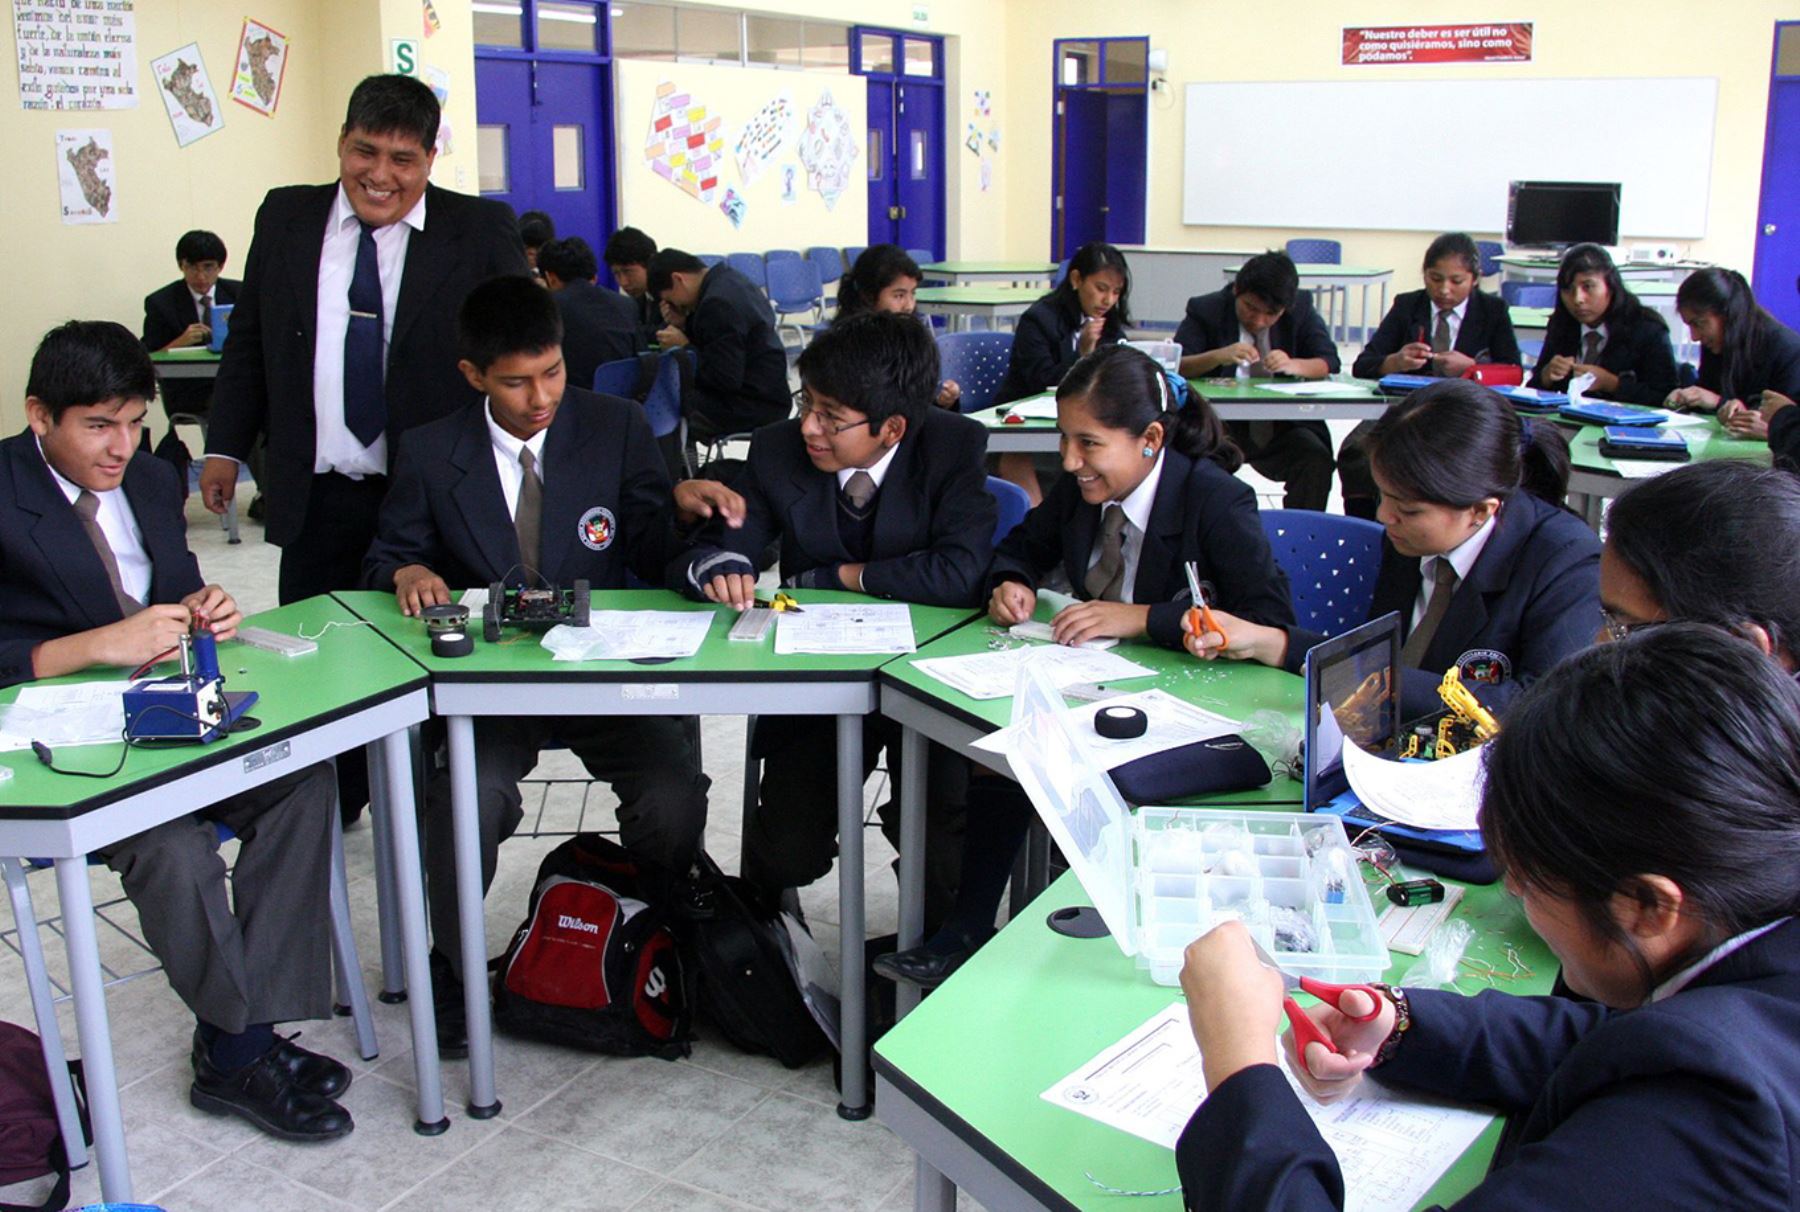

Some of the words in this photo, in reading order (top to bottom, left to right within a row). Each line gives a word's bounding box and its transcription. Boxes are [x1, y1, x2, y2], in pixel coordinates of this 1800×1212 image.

[65, 24, 75, 41] la
[1407, 28, 1439, 38] deber
[1440, 30, 1453, 38] es
[1454, 29, 1471, 38] ser
[1472, 26, 1491, 37] útil
[1493, 28, 1508, 37] no
[1359, 42, 1388, 50] como
[1458, 38, 1481, 48] sino
[1482, 40, 1513, 48] como
[397, 43, 414, 74] S
[558, 914, 598, 935] Wilson
